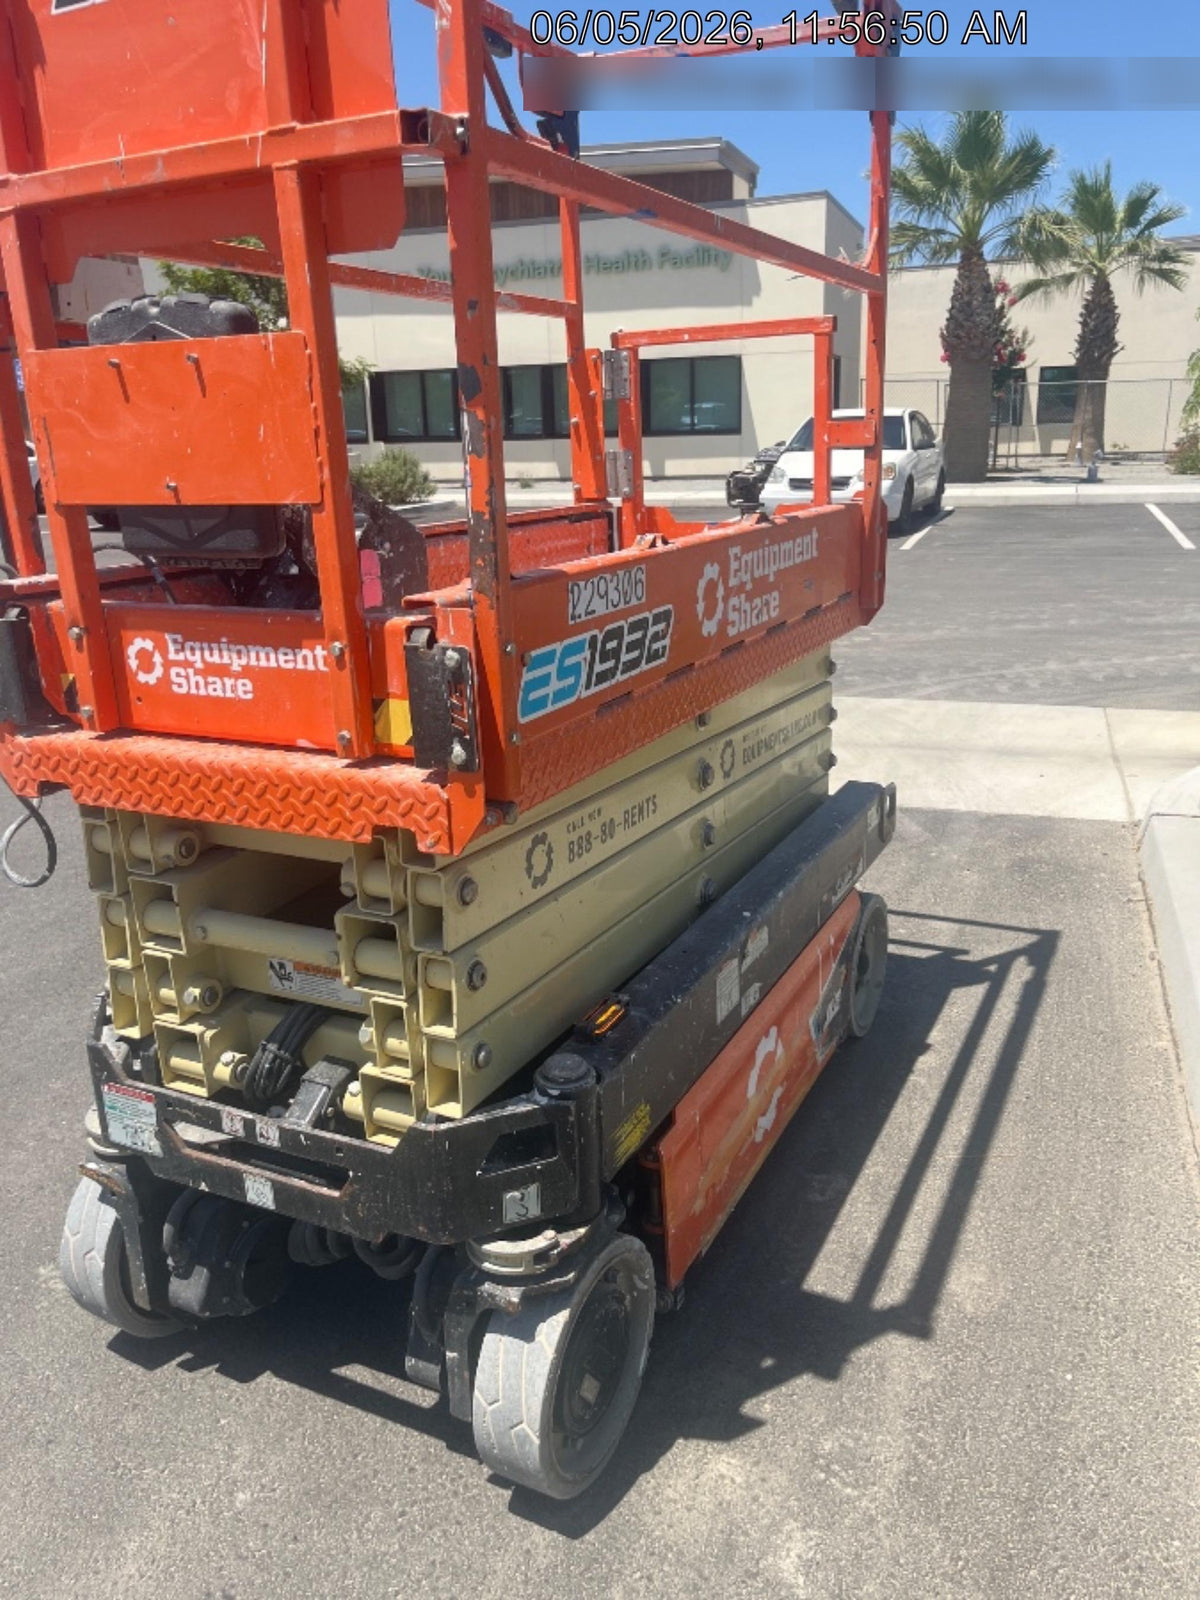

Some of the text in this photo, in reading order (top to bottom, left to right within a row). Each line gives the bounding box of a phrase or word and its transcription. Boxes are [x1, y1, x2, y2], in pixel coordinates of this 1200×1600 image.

[583, 249, 652, 275] Health
[657, 246, 732, 273] Facility
[728, 526, 819, 591] Equipment
[727, 591, 779, 637] Share
[165, 632, 328, 672] Equipment
[518, 605, 674, 723] ES1932
[169, 666, 254, 700] Share
